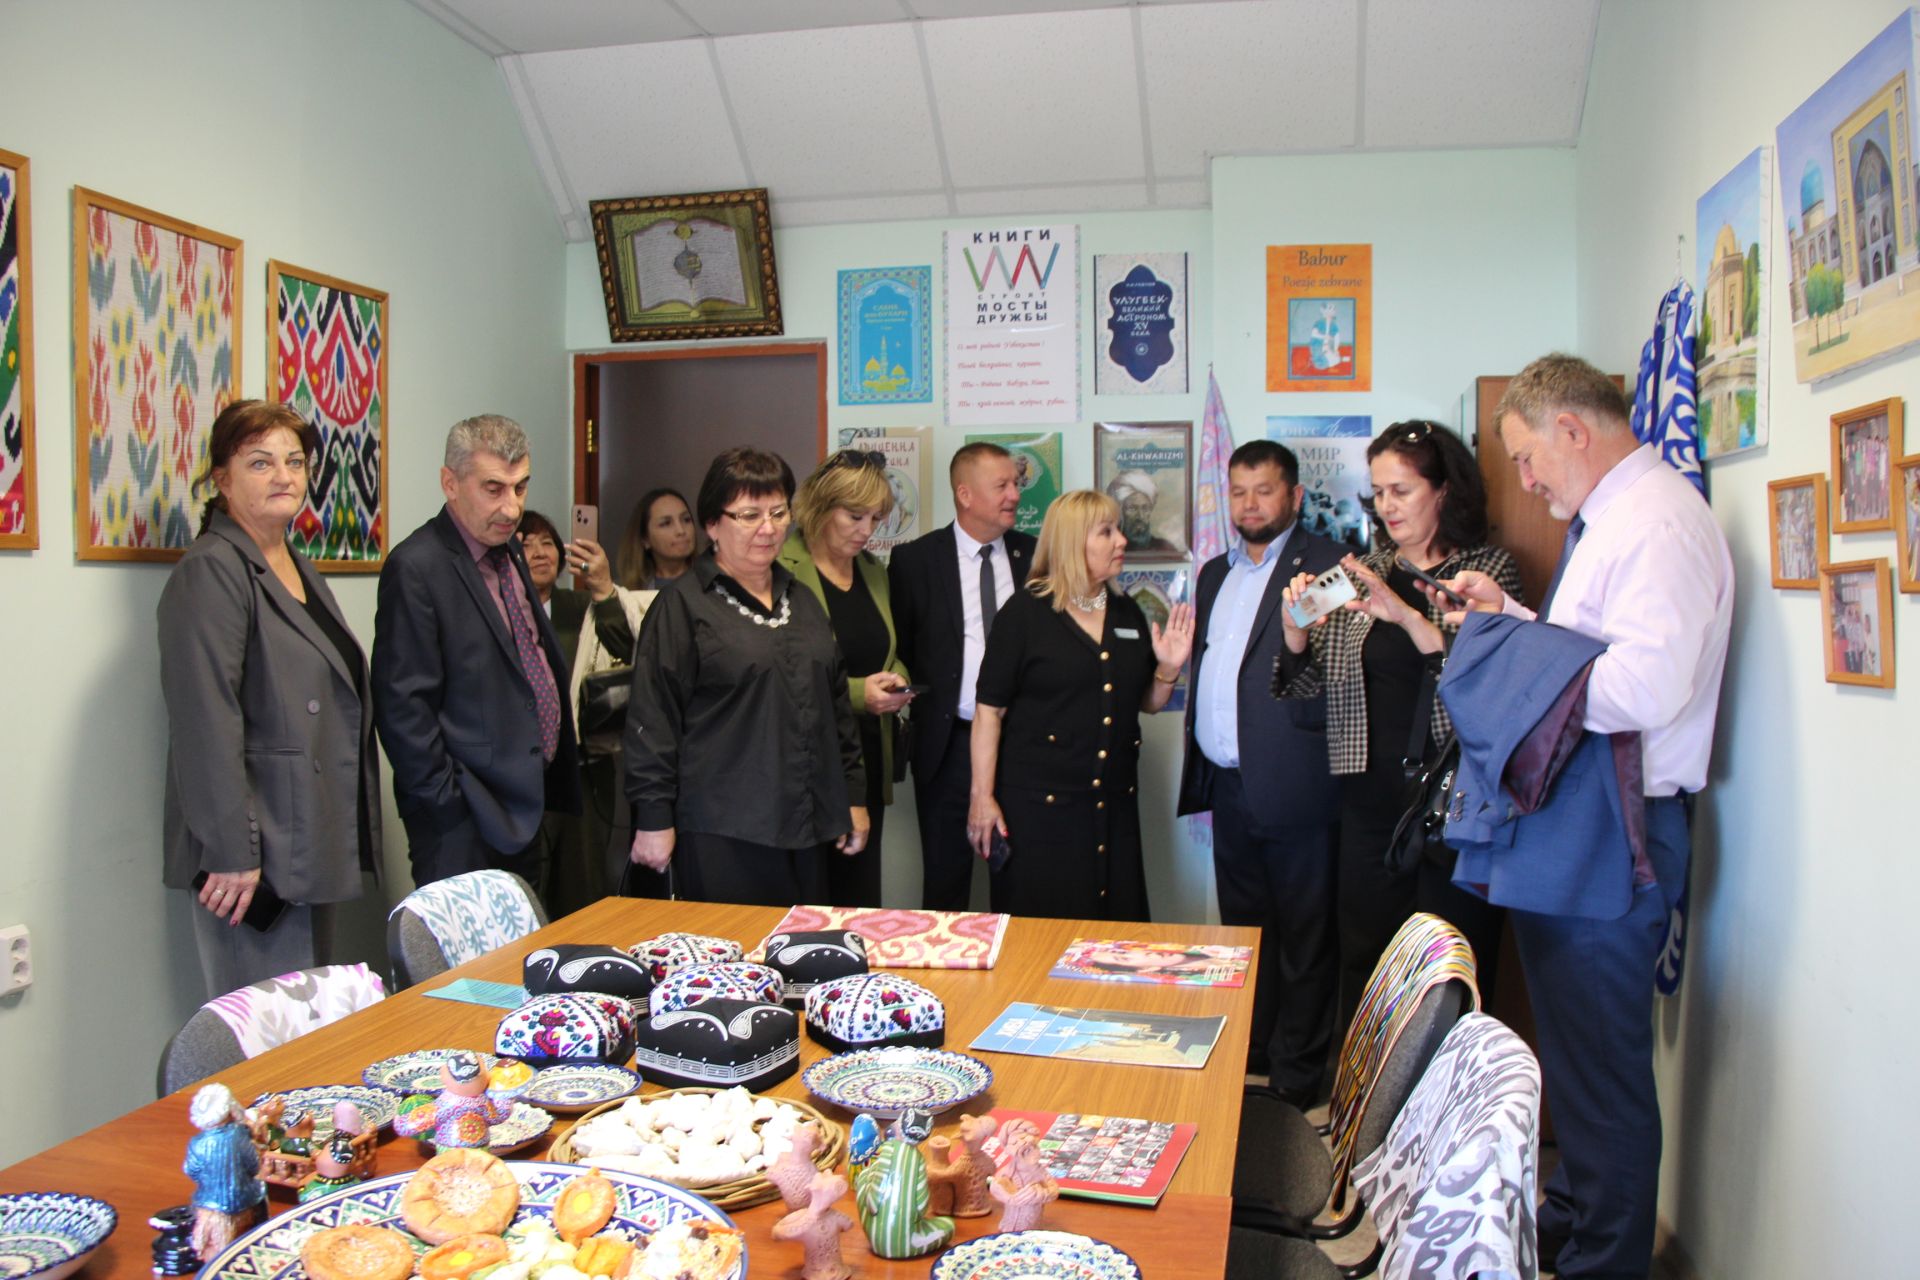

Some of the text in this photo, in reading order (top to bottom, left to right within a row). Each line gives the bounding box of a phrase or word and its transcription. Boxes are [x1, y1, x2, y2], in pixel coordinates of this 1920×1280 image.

[973, 229, 1050, 243] КНИГИ
[1298, 248, 1348, 266] Babur
[978, 292, 1045, 300] СТРОЯТ
[1113, 294, 1168, 304] УЛУГБЕК
[977, 300, 1047, 312] МОСТЫ
[977, 312, 1047, 324] ДРУЖБЫ
[1117, 313, 1167, 322] АСТРОНОМ
[1116, 451, 1184, 460] AL-KHWARIZMI
[1298, 462, 1345, 476] ЕМУР
